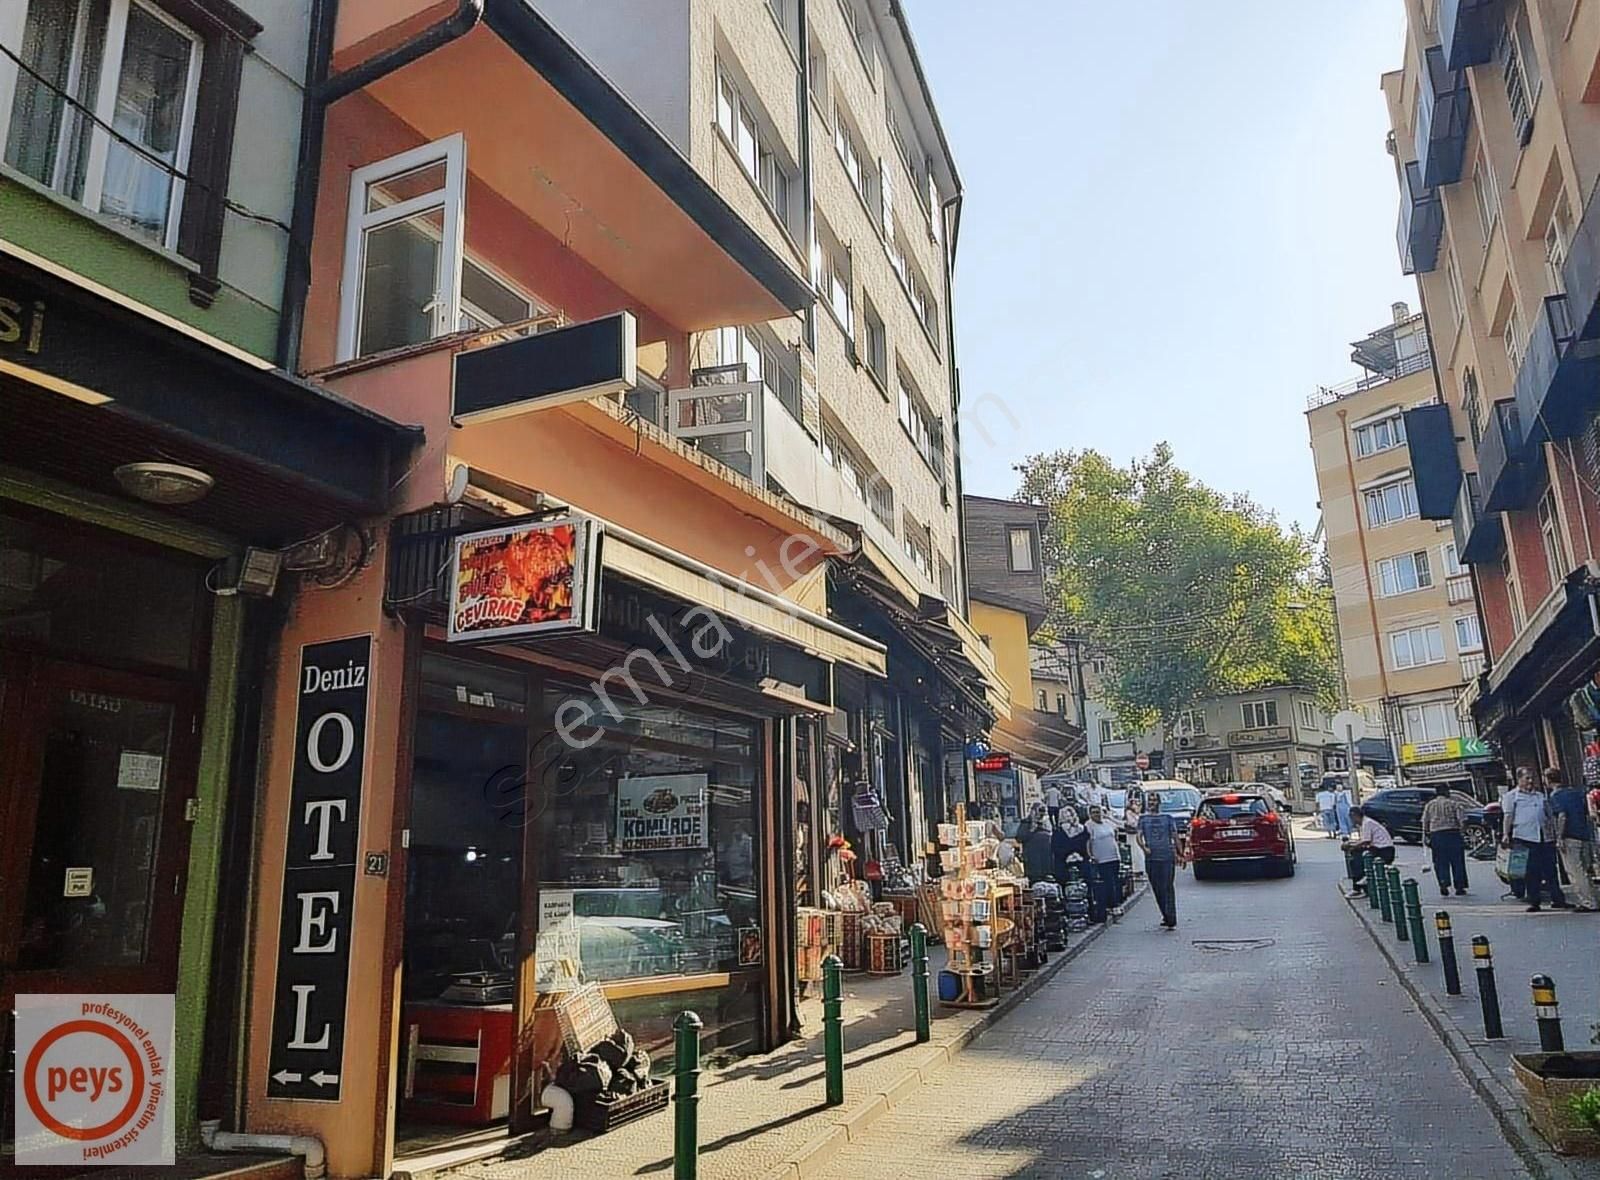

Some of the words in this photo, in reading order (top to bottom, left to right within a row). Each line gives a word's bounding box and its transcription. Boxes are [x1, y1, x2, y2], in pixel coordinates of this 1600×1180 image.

[303, 659, 365, 694] Deniz
[287, 711, 355, 1050] OTEL
[369, 856, 382, 870] 21
